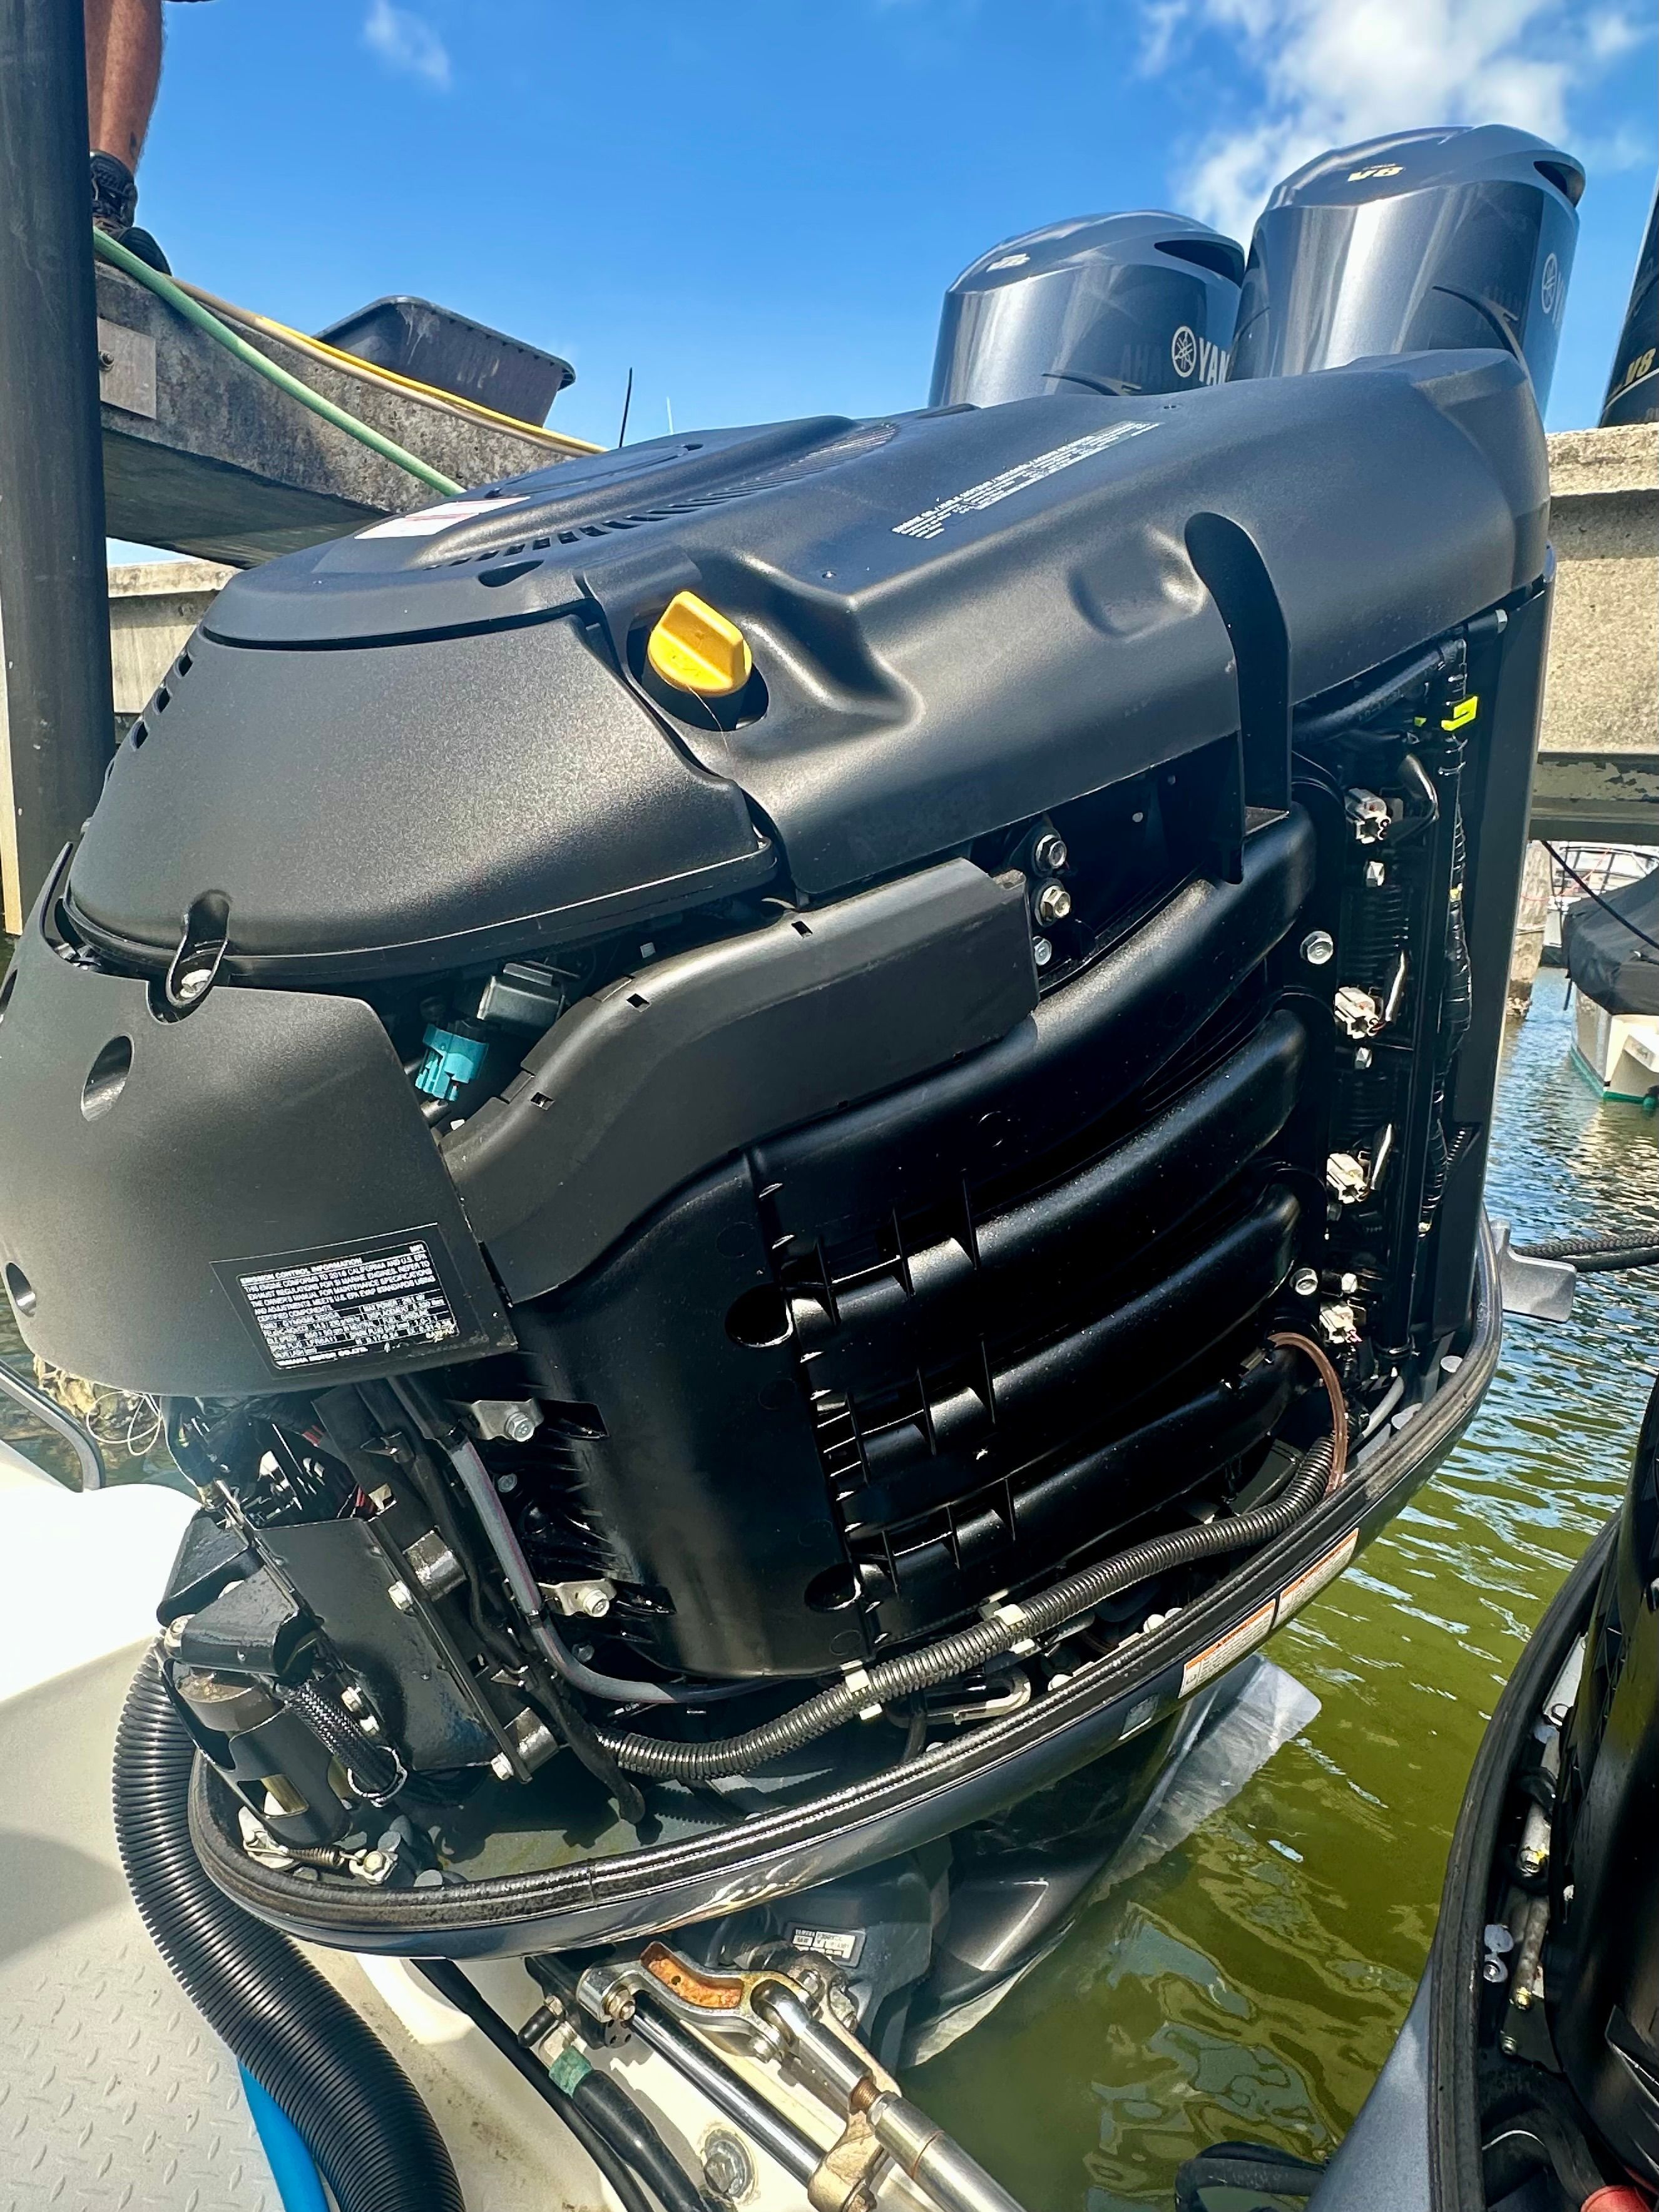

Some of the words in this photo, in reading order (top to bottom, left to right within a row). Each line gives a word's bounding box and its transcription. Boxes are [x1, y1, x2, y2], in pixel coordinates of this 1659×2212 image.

[274, 1267, 310, 1279] CONTROL
[310, 1257, 362, 1272] INFORMATION
[282, 1274, 319, 1288] CONFORMS
[346, 1262, 386, 1275] CALIFORNIA
[385, 1259, 401, 1267] AND
[275, 1282, 320, 1297] REGULATIONS
[318, 1280, 334, 1289] FOR
[340, 1274, 367, 1284] MARINE
[318, 1288, 334, 1296] FOR
[378, 1267, 434, 1284] SPECIFICATIONS
